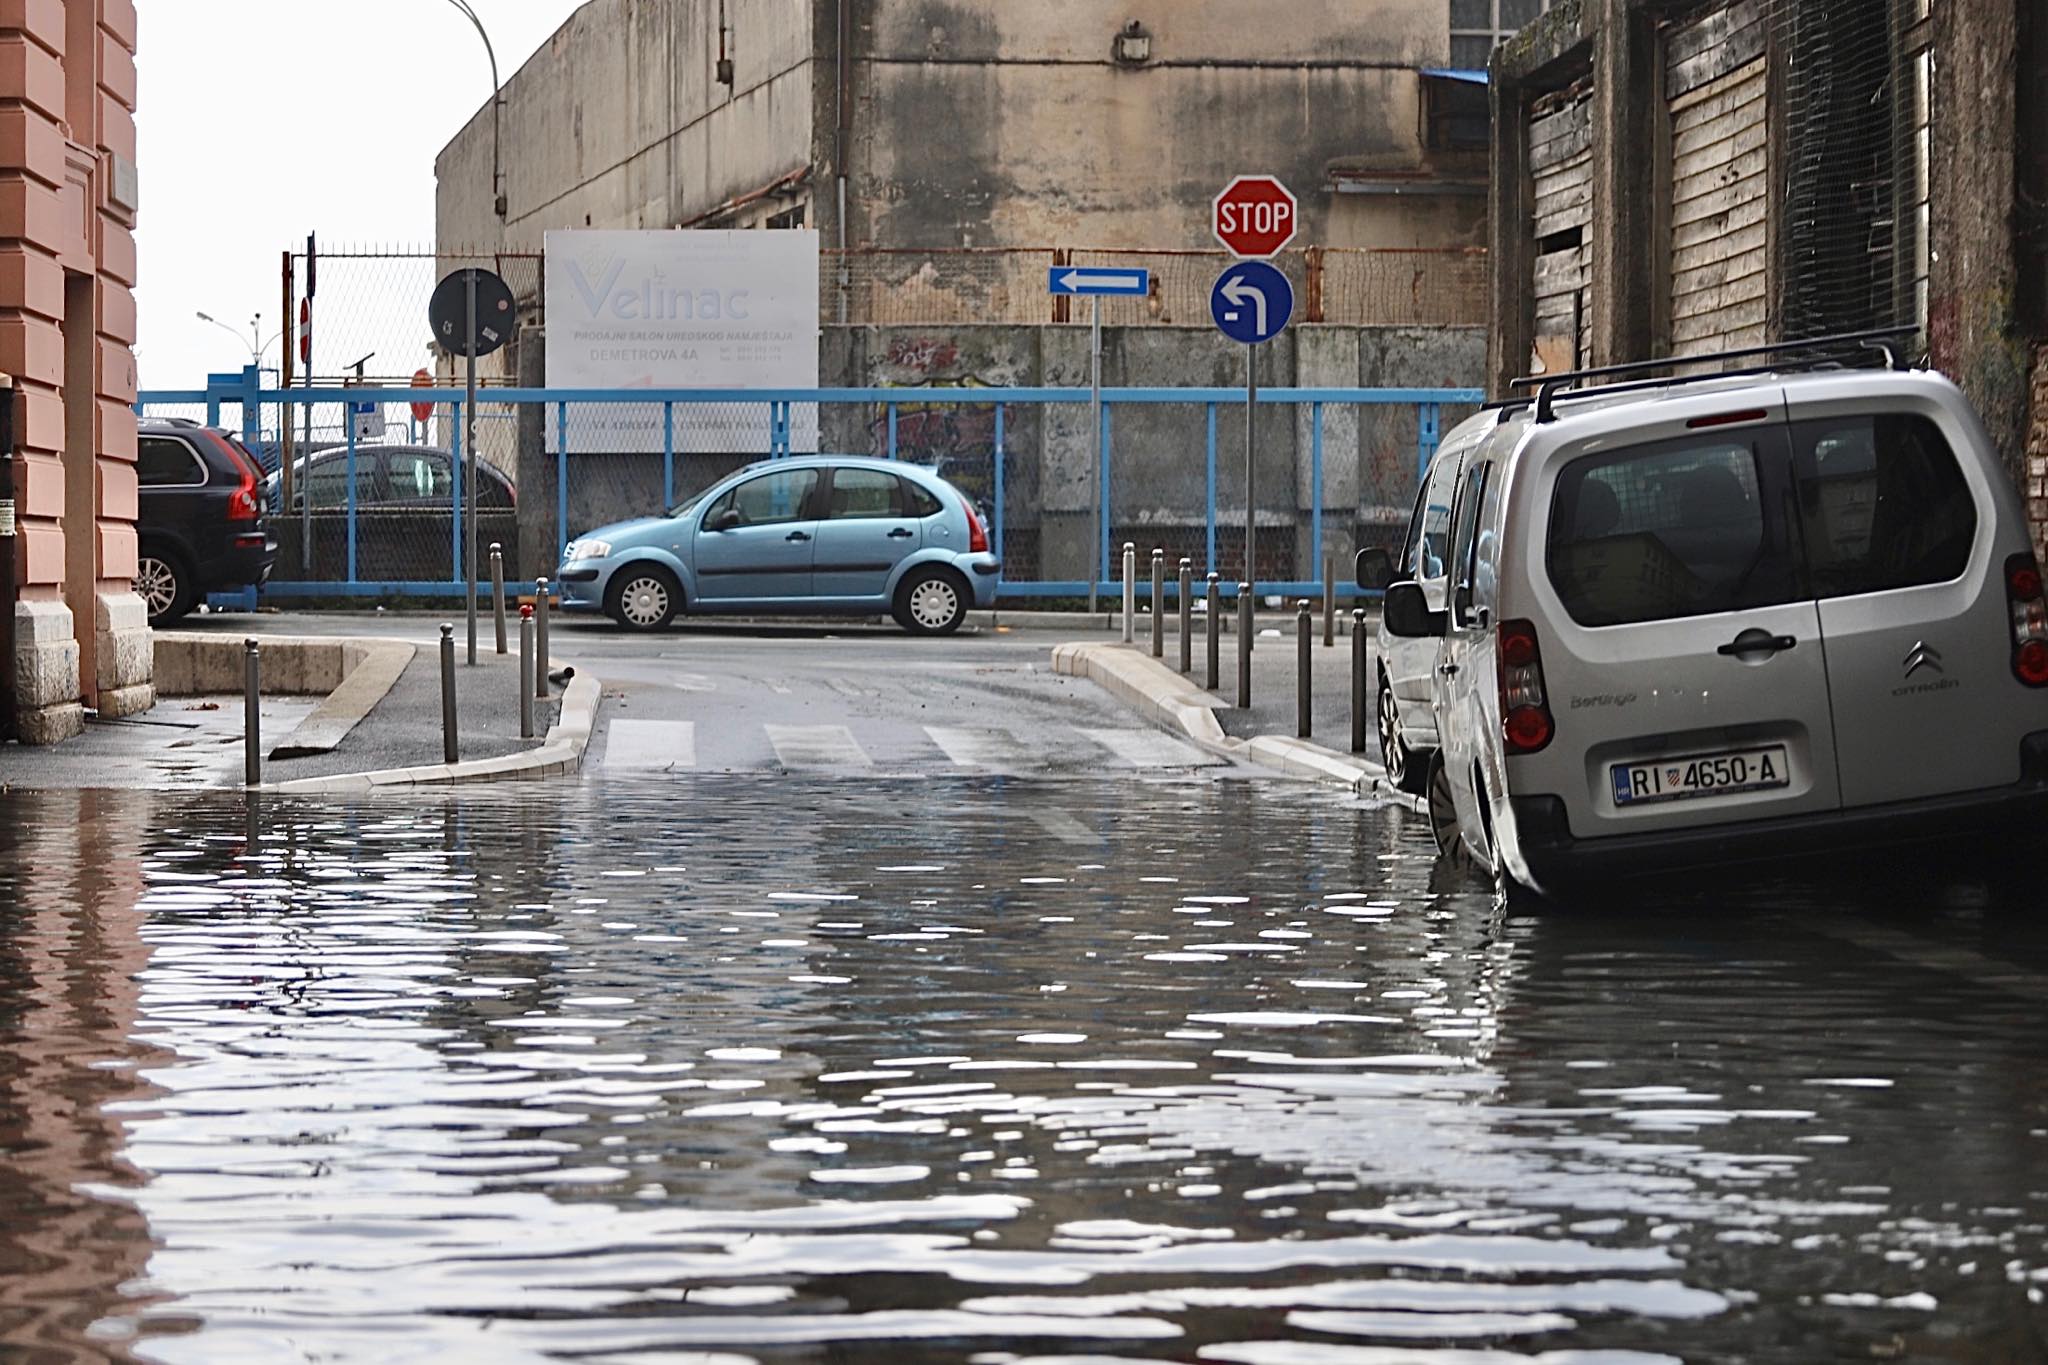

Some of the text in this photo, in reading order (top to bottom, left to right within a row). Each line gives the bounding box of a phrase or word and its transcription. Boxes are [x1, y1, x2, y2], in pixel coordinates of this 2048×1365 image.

[1220, 202, 1289, 234] STOP
[562, 257, 750, 321] Velinac
[590, 348, 698, 361] DEMETROVA 4A
[1683, 754, 1776, 789] 4650-A
